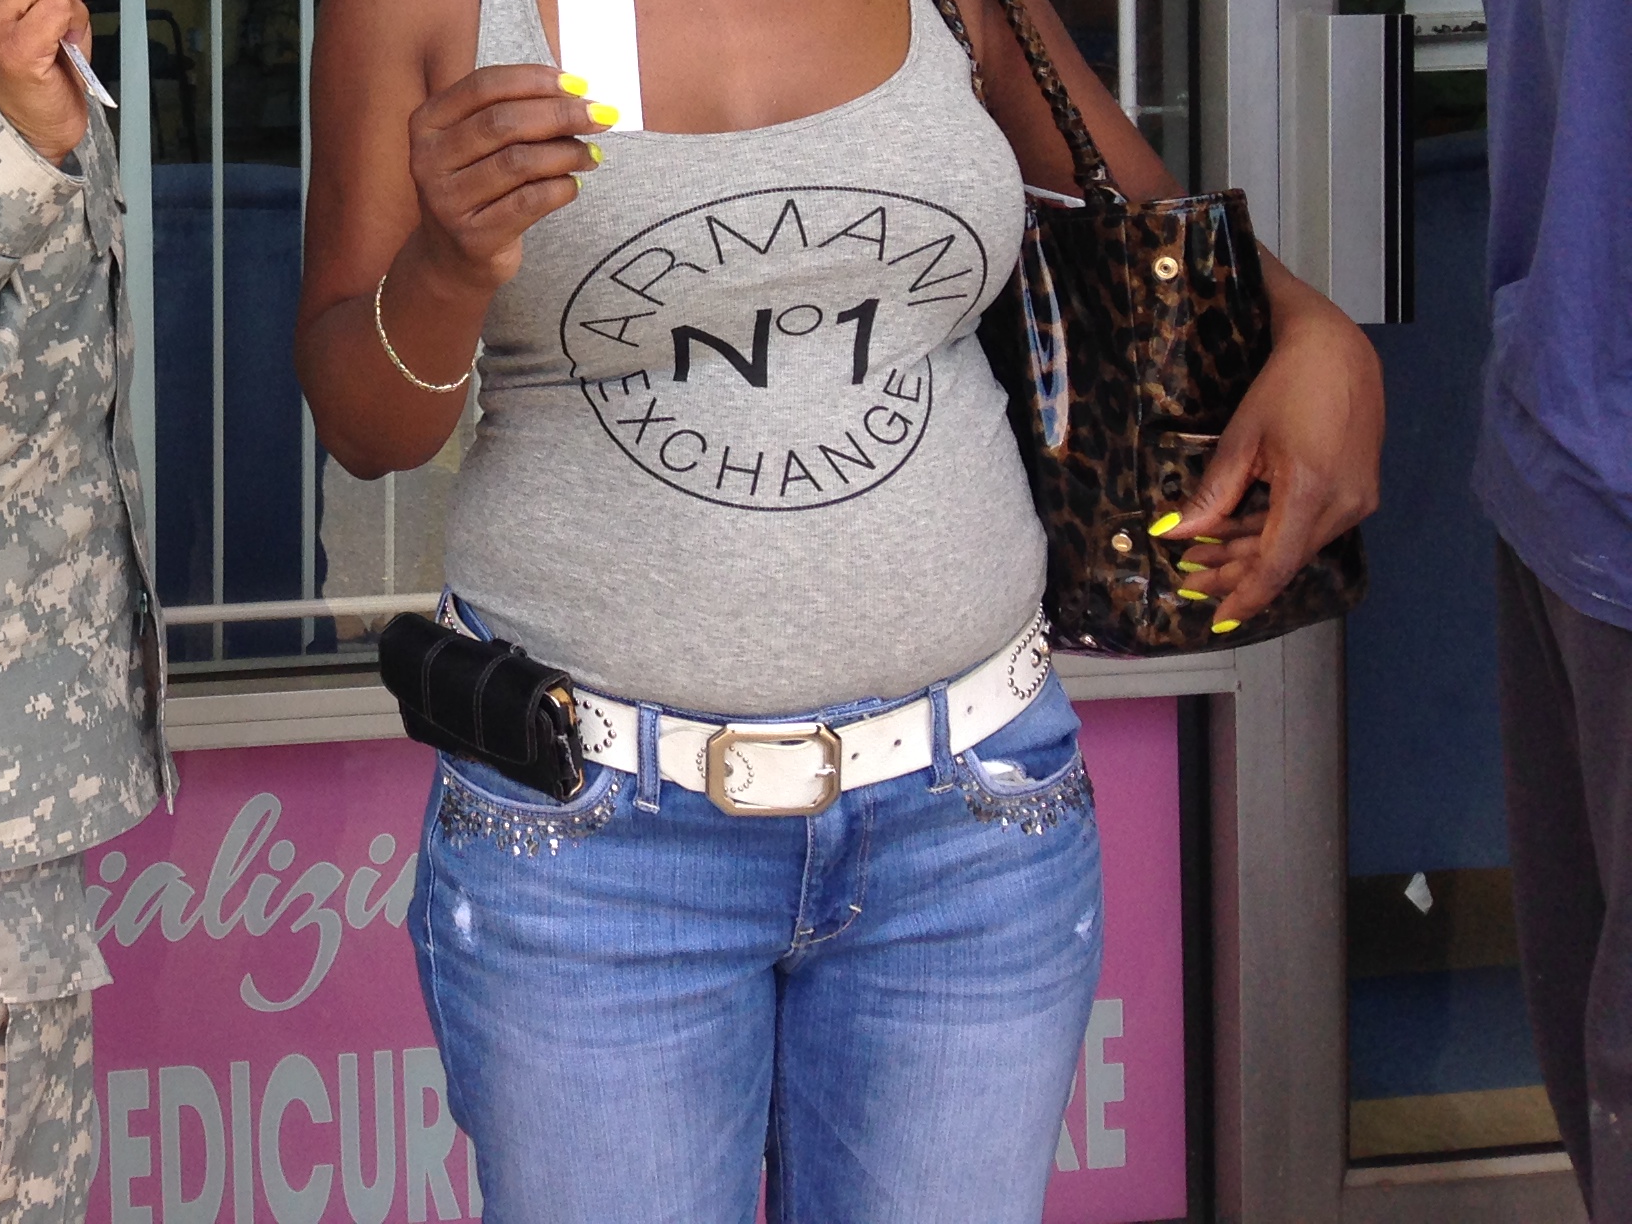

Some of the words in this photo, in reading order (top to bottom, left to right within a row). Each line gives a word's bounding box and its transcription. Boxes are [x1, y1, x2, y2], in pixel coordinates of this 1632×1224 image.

[579, 198, 973, 347] ARMANI
[597, 368, 923, 496] EXCHANGE
[89, 1046, 485, 1224] EDICUR
